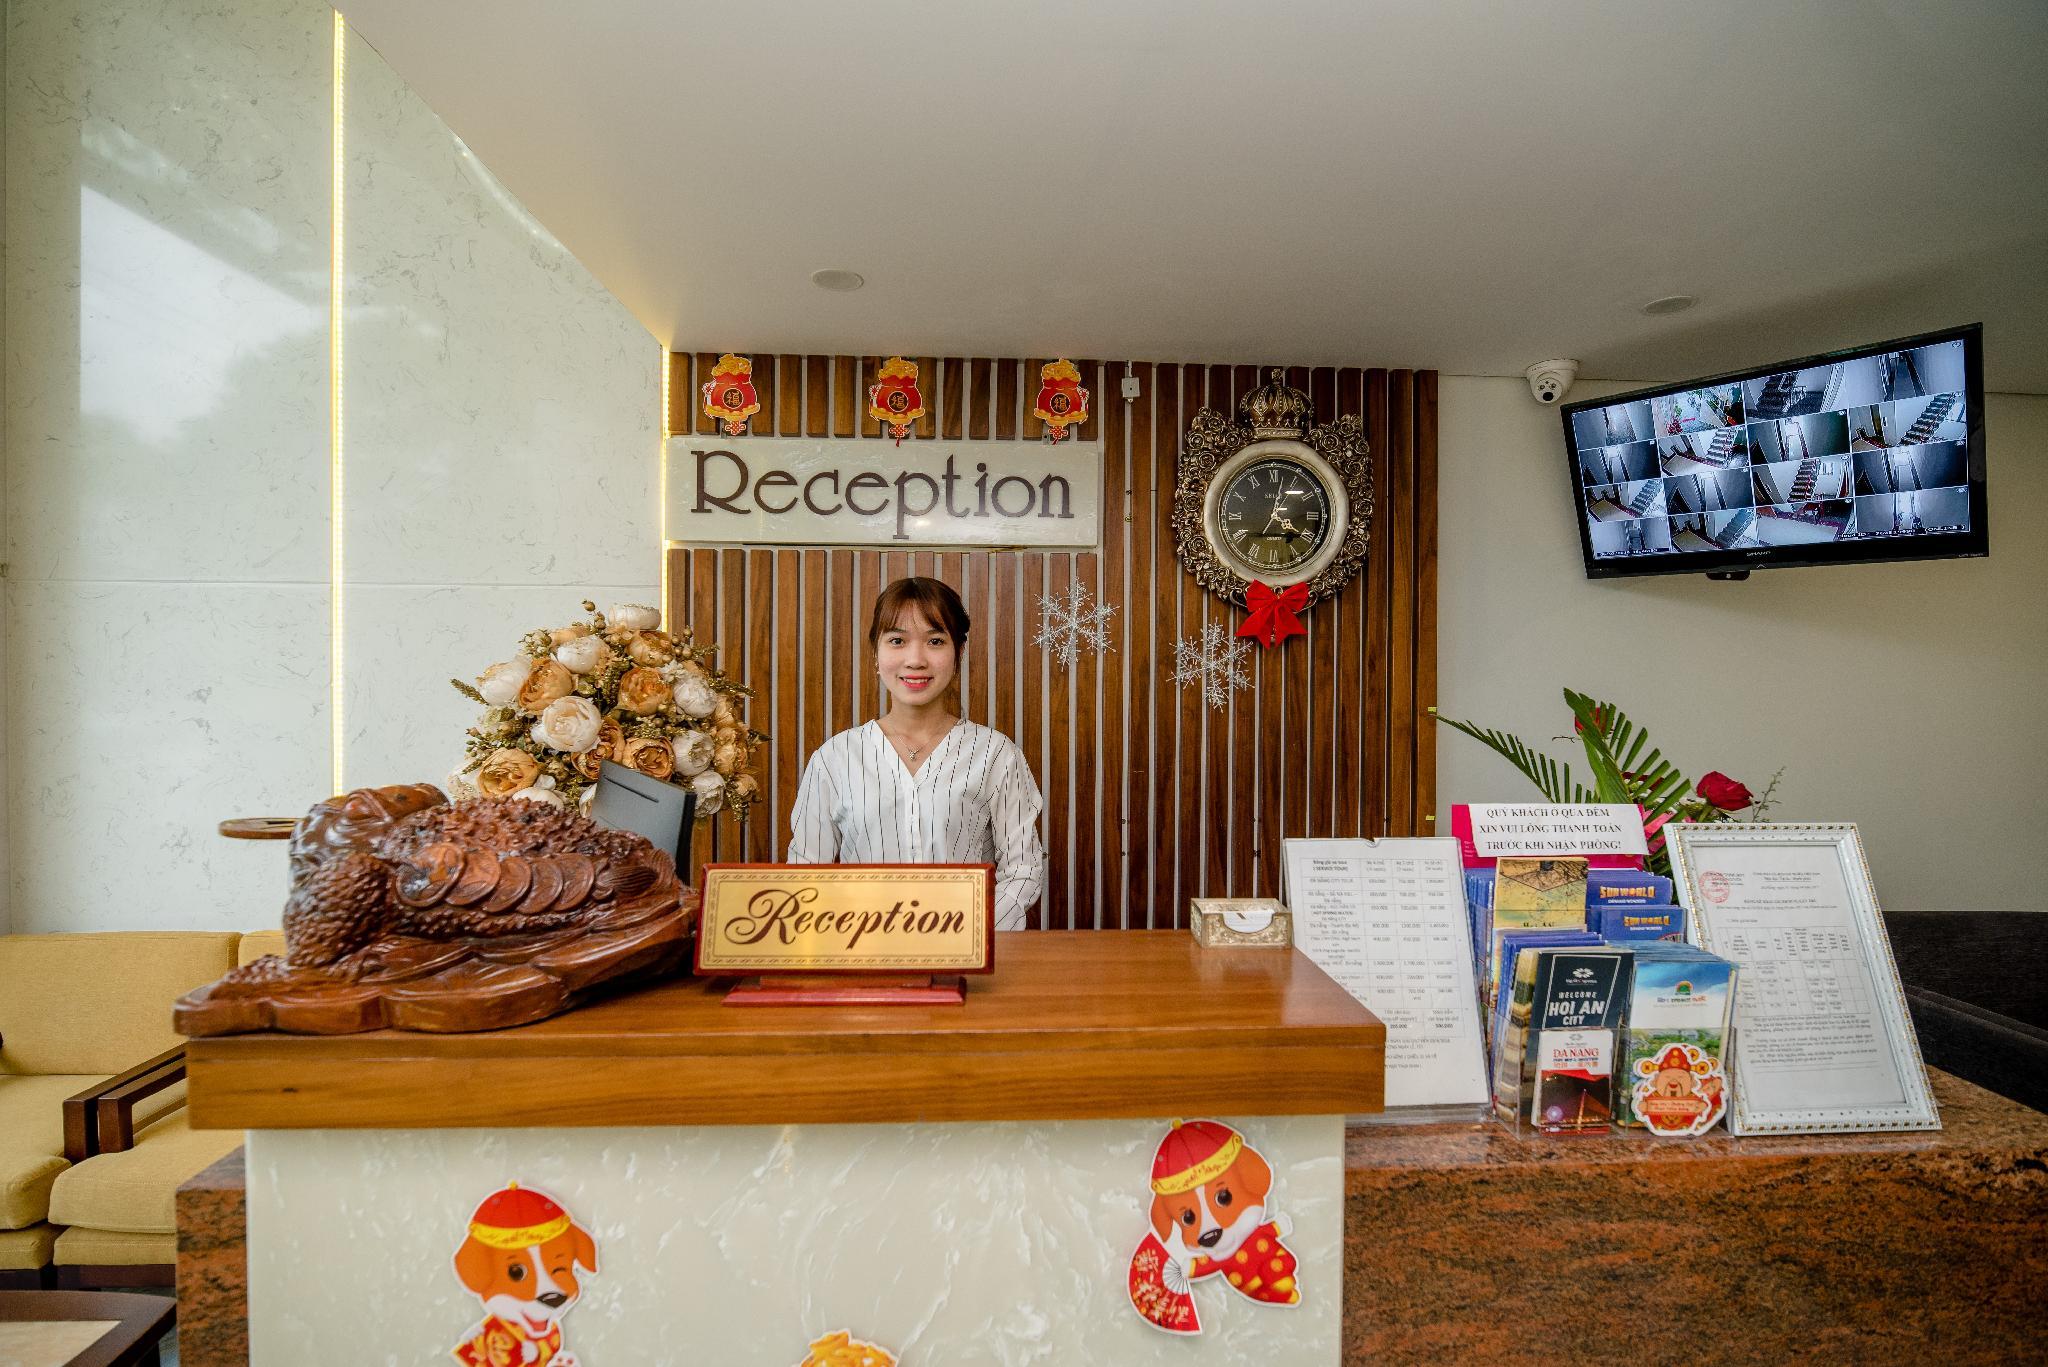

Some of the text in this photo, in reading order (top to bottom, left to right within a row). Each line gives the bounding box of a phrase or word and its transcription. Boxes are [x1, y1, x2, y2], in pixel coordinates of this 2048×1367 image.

[690, 450, 1075, 540] Reception
[1511, 806, 1548, 817] KHÁCH
[1561, 808, 1584, 818] QUA
[1586, 806, 1610, 817] ĐÊM
[1479, 822, 1623, 833] XIN VUI LÒNG THANH TOÁN
[1486, 839, 1524, 850] TRƯỚC
[1525, 841, 1544, 850] KHI
[1546, 840, 1577, 851] NHẬN
[1580, 839, 1622, 850] PHÒNG!
[1599, 886, 1656, 898] SUN WORLD
[724, 886, 965, 950] Reception
[1558, 991, 1597, 999] WELCOME
[1548, 1000, 1606, 1016] HOI AN
[1562, 1015, 1585, 1025] CITY
[1553, 1047, 1600, 1058] DA NANG
